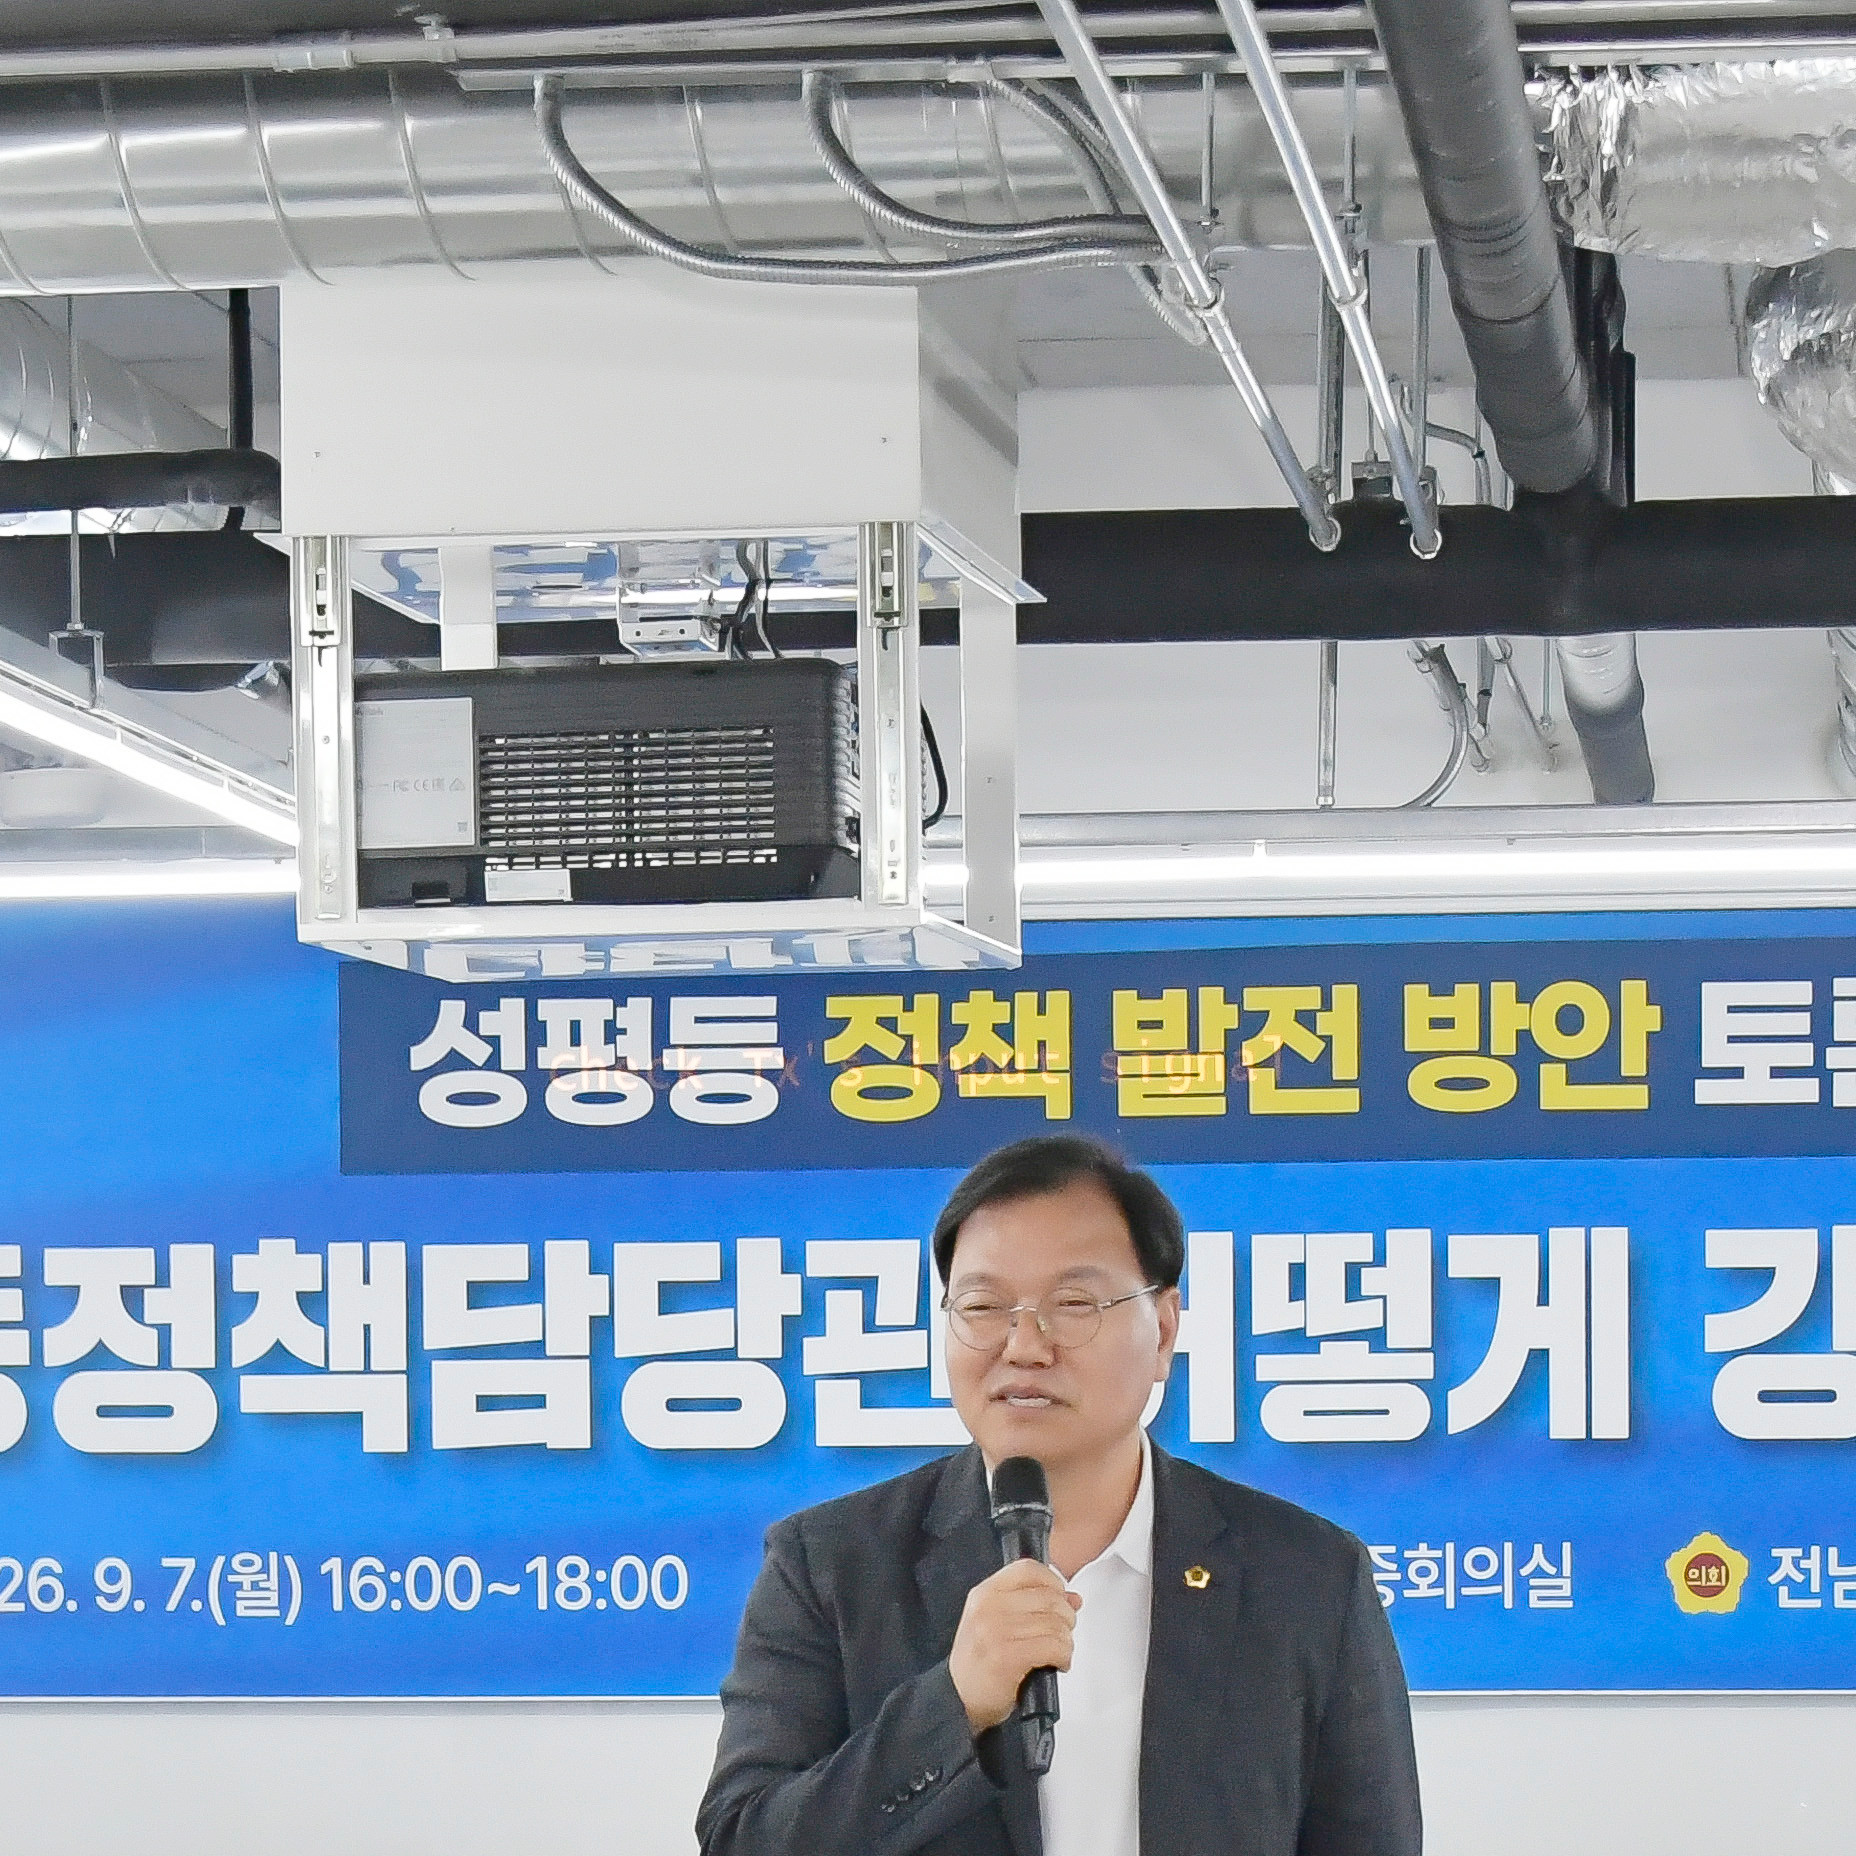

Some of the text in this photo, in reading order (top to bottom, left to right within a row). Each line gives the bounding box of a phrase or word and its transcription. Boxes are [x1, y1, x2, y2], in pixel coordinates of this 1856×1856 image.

[409, 994, 786, 1129] 성평등
[824, 989, 1072, 1123] 정책
[1112, 983, 1361, 1118] 발전
[1405, 978, 1662, 1114] 방안
[93, 1556, 147, 1613] 9.
[160, 1550, 303, 1627] 7.(월)
[319, 1553, 690, 1613] 16:00~18:00
